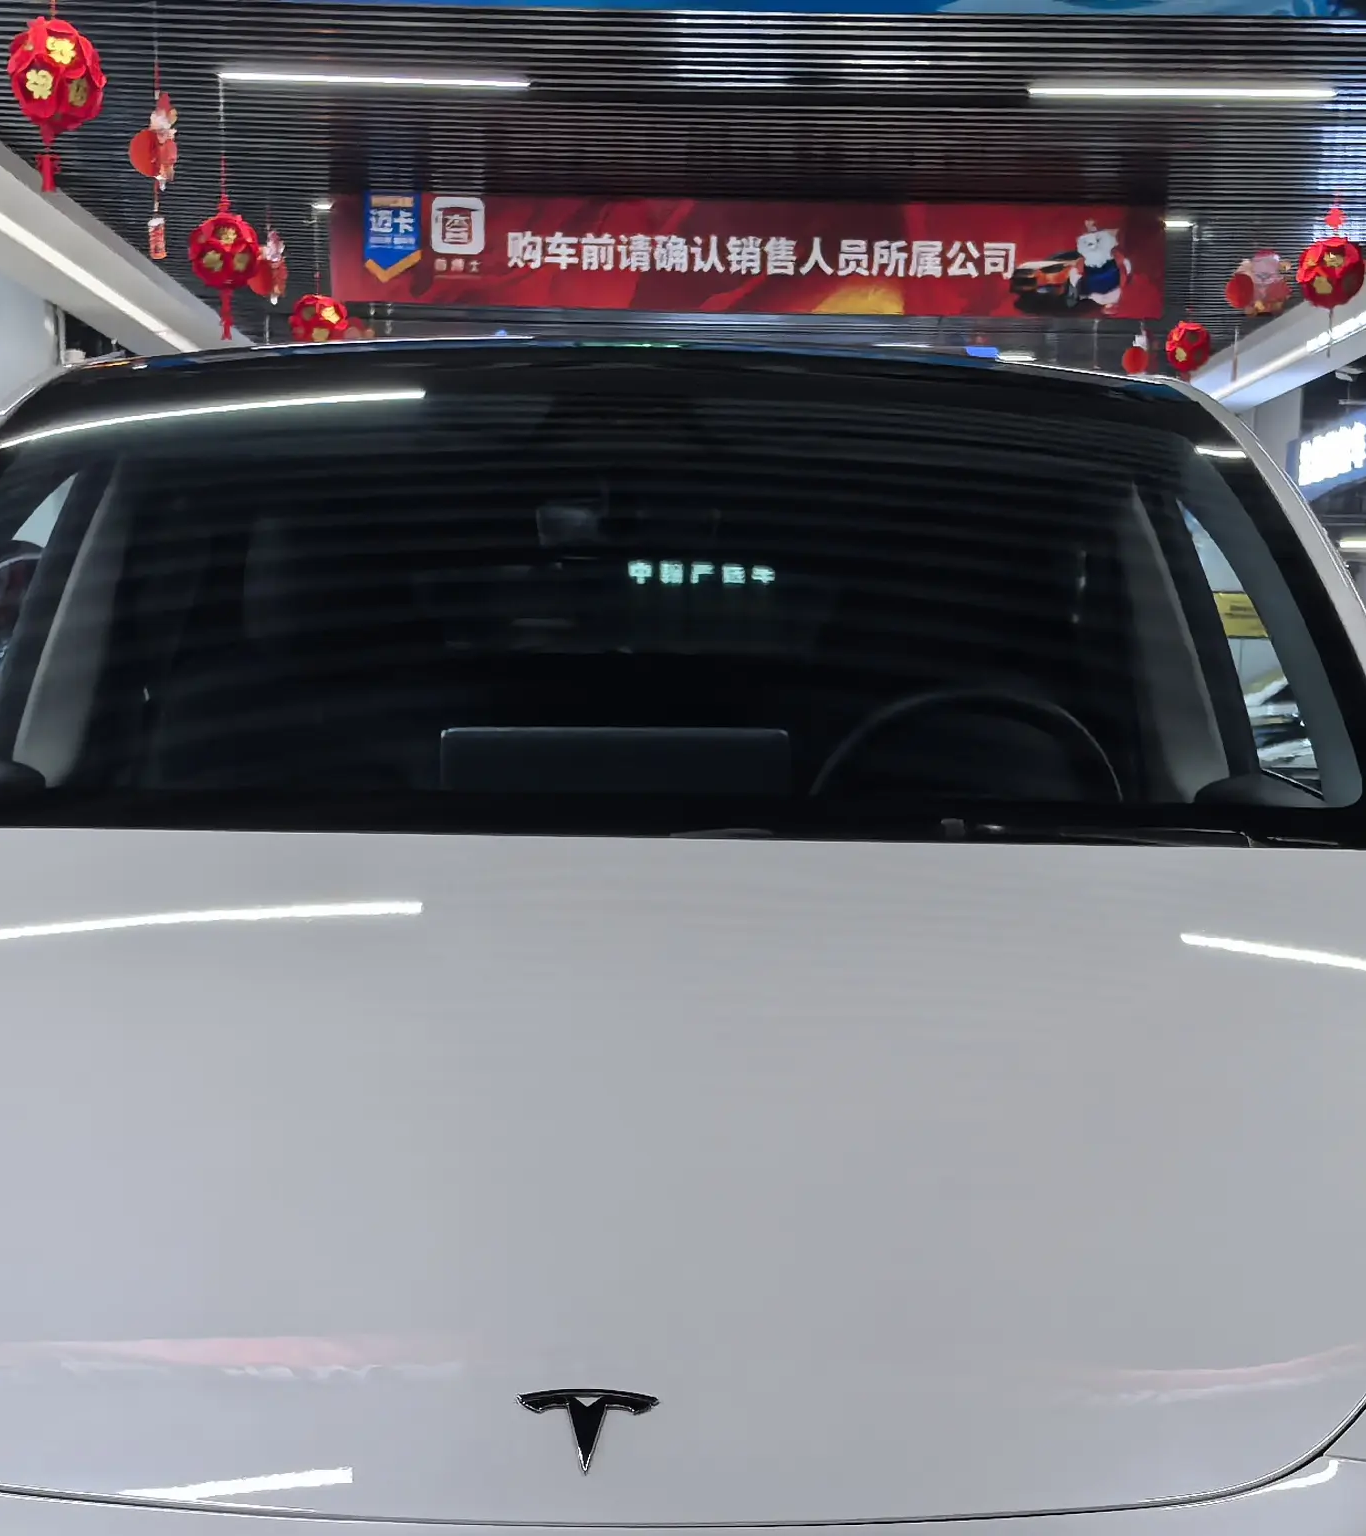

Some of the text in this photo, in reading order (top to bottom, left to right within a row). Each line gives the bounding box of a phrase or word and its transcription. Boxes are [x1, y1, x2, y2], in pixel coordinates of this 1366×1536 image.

[507, 231, 1017, 279] 购车前请确认销售人员所属公司
